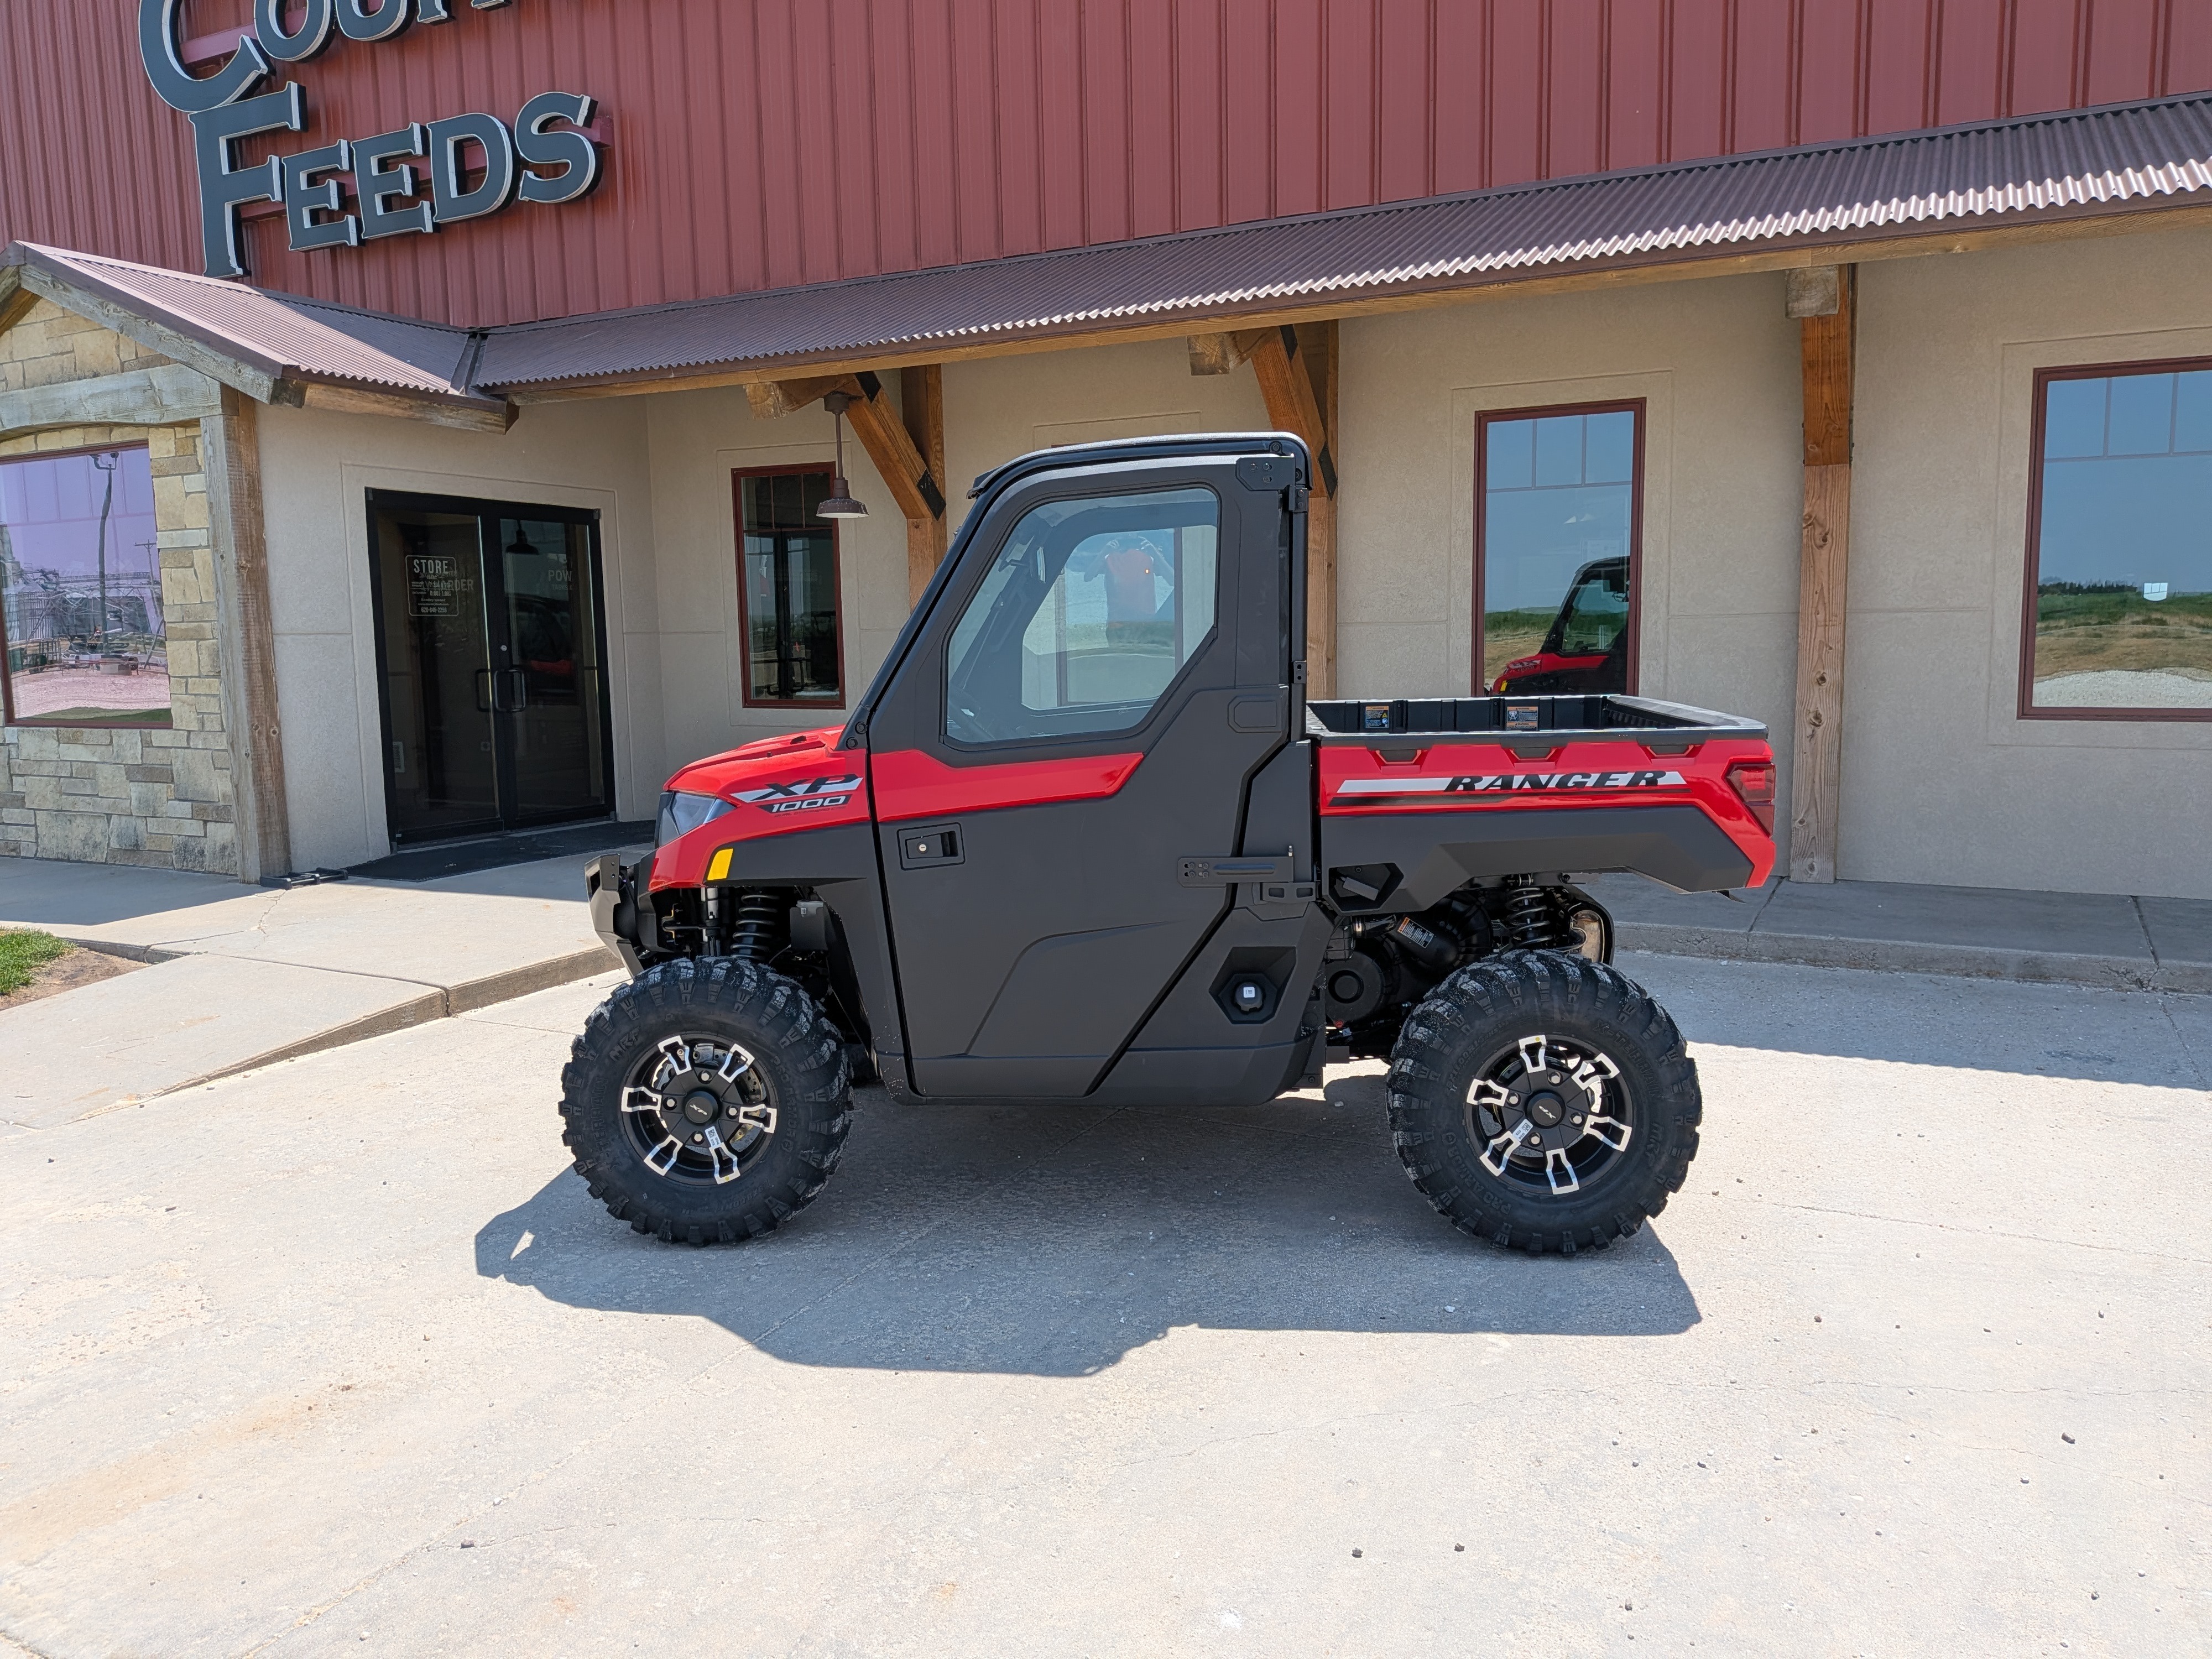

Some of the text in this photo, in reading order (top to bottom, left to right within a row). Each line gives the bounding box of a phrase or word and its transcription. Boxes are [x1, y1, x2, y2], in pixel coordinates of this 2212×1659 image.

[188, 81, 601, 278] FEEDS
[413, 559, 448, 574] STORE
[750, 774, 859, 801] XP
[772, 796, 846, 812] 1000
[1443, 771, 1666, 792] RANGER
[1593, 1019, 1662, 1098] X-TERRAIN
[590, 1077, 622, 1172] X-TERRAIN
[1447, 1146, 1512, 1215] PRO ARMOR
